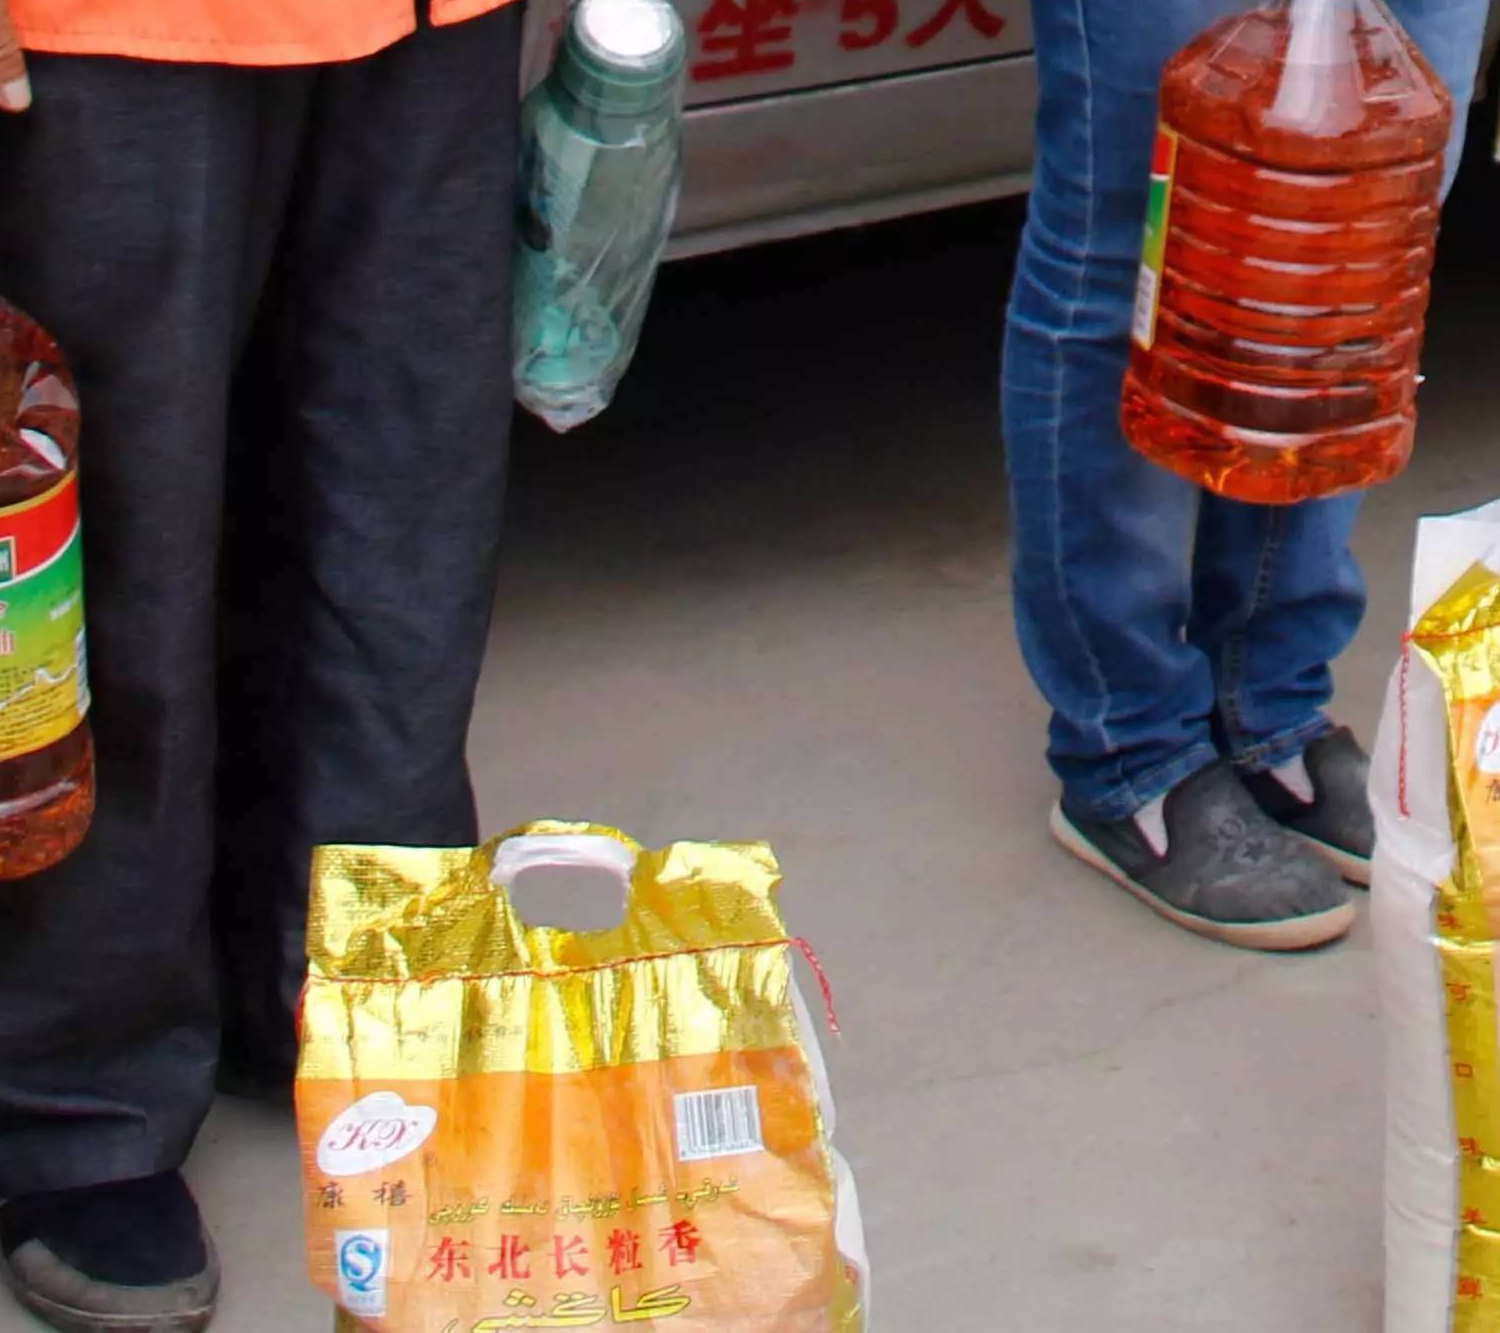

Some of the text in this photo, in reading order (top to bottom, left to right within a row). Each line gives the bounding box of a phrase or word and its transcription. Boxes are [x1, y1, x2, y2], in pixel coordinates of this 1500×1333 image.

[316, 1179, 413, 1209] 康禧
[427, 1219, 701, 1282] 东北长粒香
